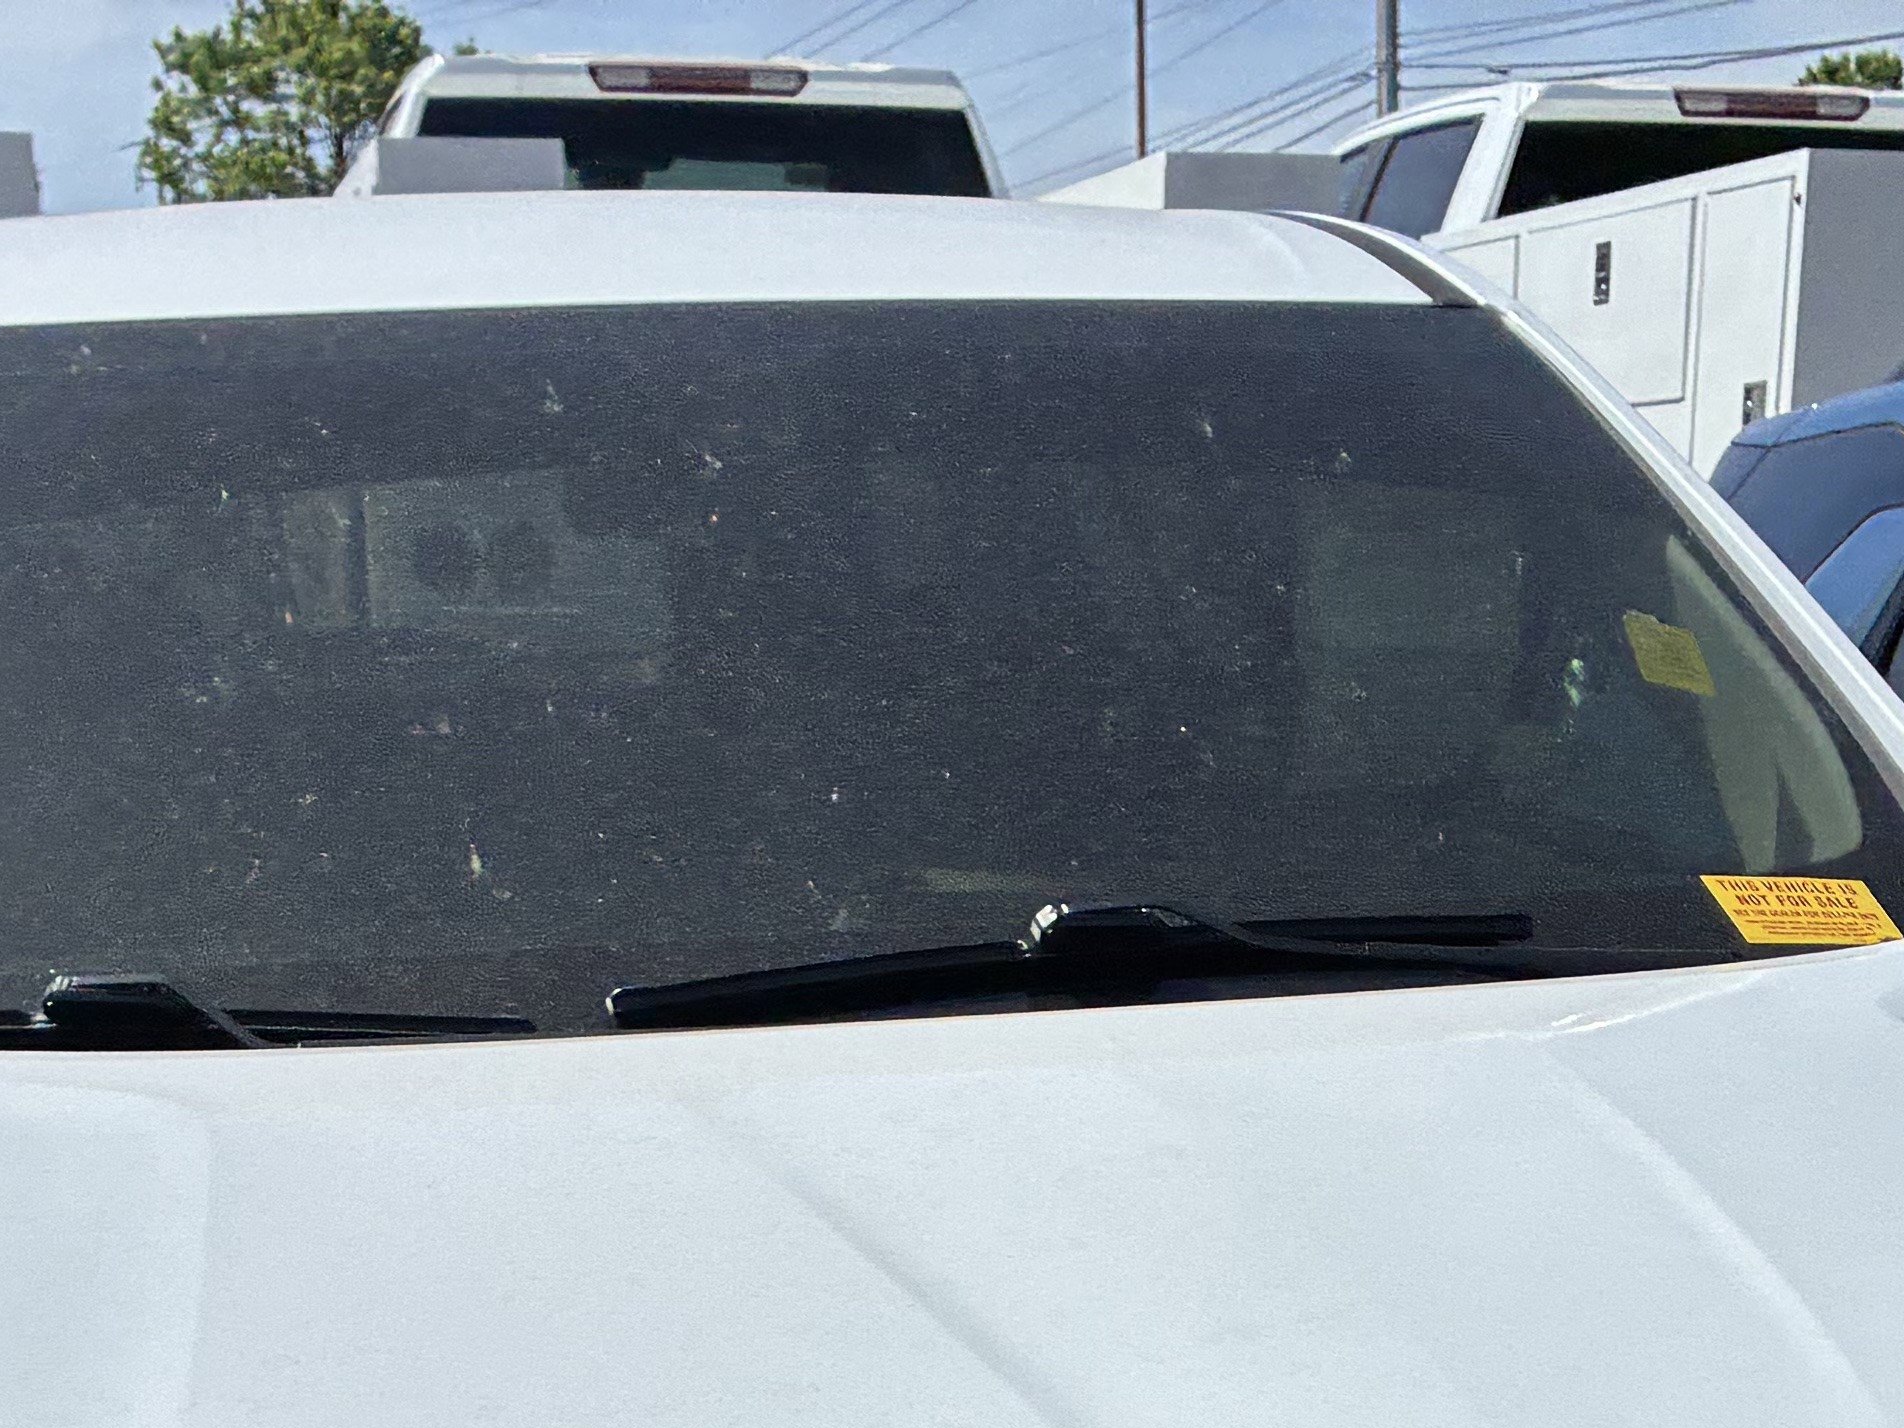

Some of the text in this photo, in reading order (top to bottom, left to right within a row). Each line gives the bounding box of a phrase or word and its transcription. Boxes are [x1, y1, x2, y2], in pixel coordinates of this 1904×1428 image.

[1716, 879, 1858, 896] THIS VEHICLE IS
[1735, 893, 1859, 910] NOT FOR SALE
